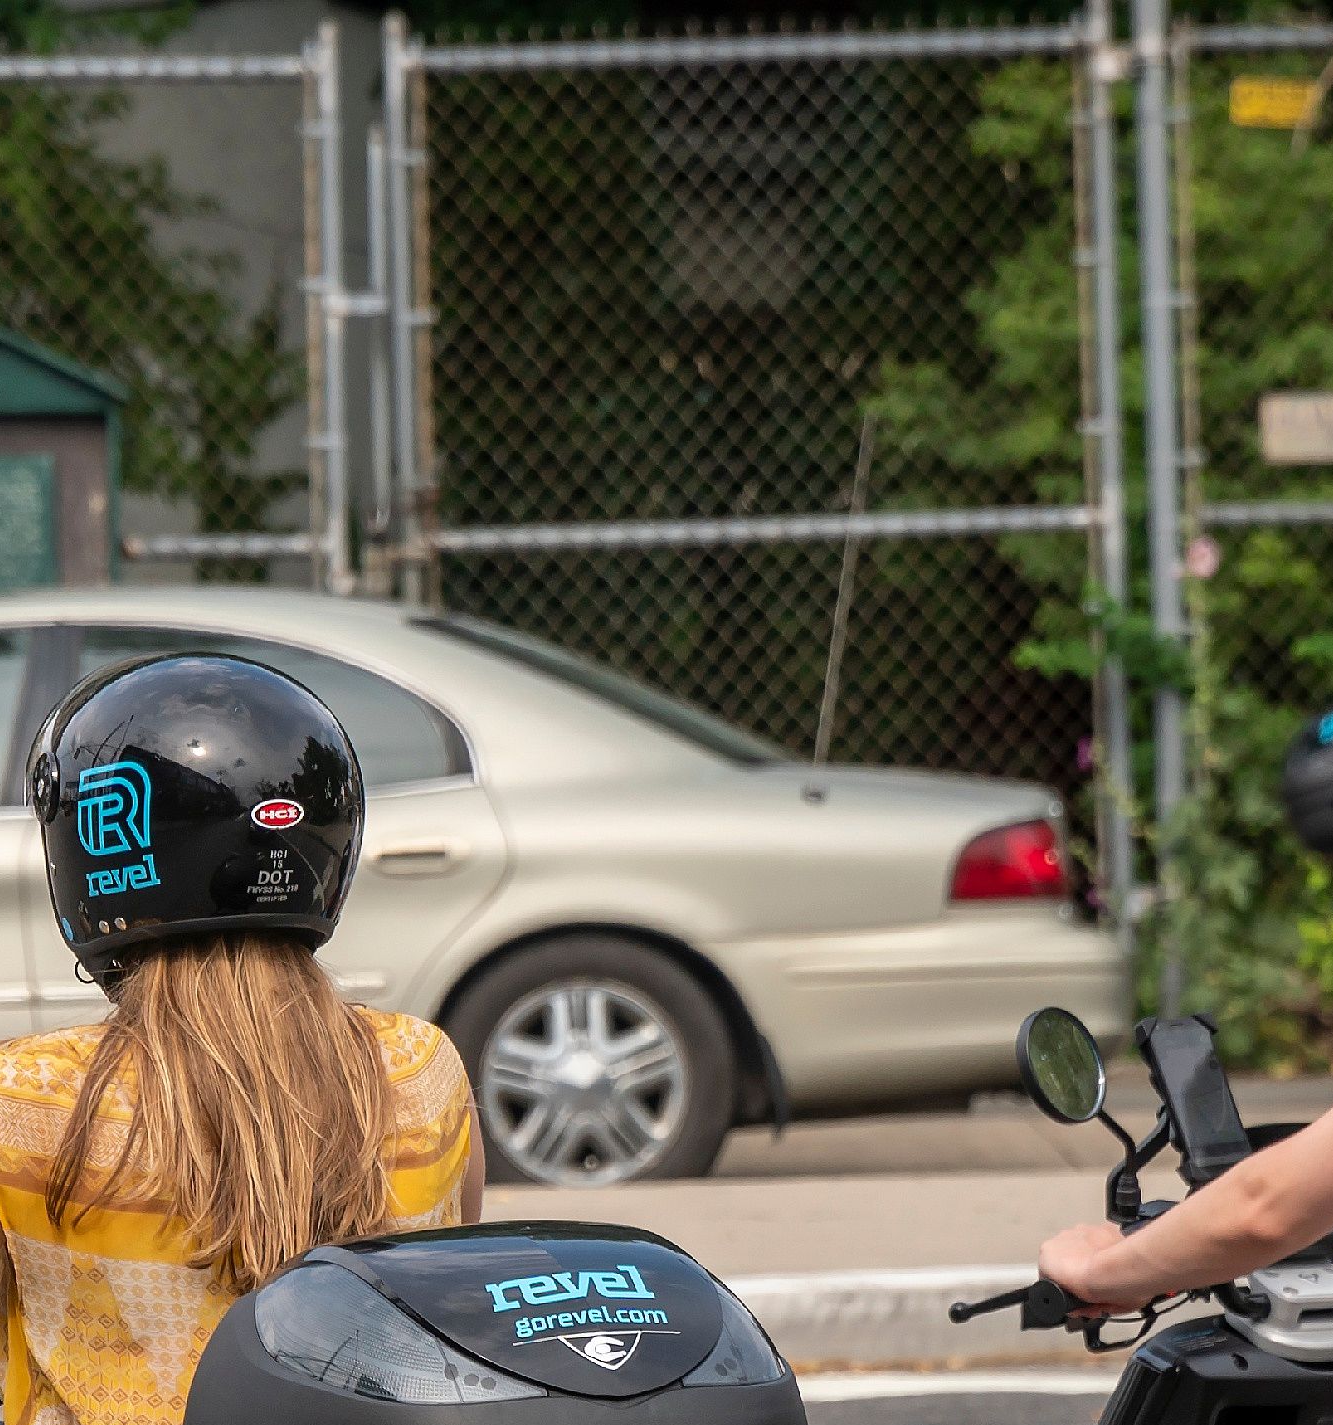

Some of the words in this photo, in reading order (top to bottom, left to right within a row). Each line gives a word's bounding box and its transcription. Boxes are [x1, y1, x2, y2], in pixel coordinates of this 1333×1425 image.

[86, 854, 161, 897] revel
[257, 869, 294, 885] DOT
[484, 1264, 655, 1313] revel
[515, 1305, 669, 1338] gorevel.com
